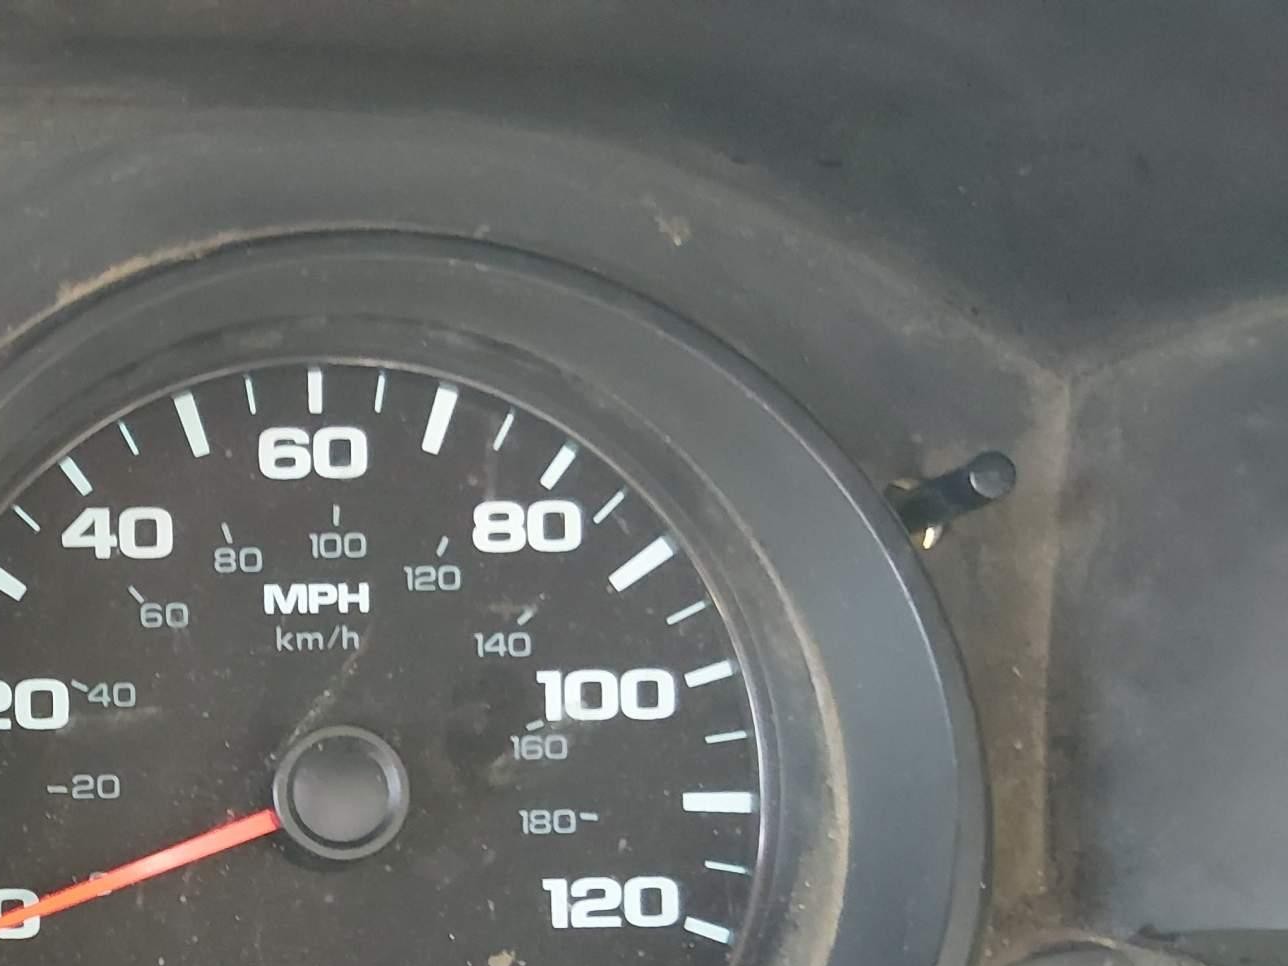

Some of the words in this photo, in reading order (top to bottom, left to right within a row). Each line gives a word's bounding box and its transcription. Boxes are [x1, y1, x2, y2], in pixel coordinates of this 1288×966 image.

[258, 426, 368, 480] 60
[61, 506, 173, 559] 40
[472, 498, 583, 553] 80
[309, 530, 368, 560] 100
[213, 546, 263, 575] 80
[403, 563, 463, 593] 120
[263, 583, 370, 615] MPH
[140, 602, 189, 629] 60
[274, 627, 361, 653] km/h
[474, 630, 533, 660] 140
[87, 681, 136, 708] 40
[536, 668, 676, 722] 100
[510, 735, 568, 763] 160
[71, 773, 120, 801] 20
[519, 808, 576, 837] 180
[541, 875, 680, 929] 120
